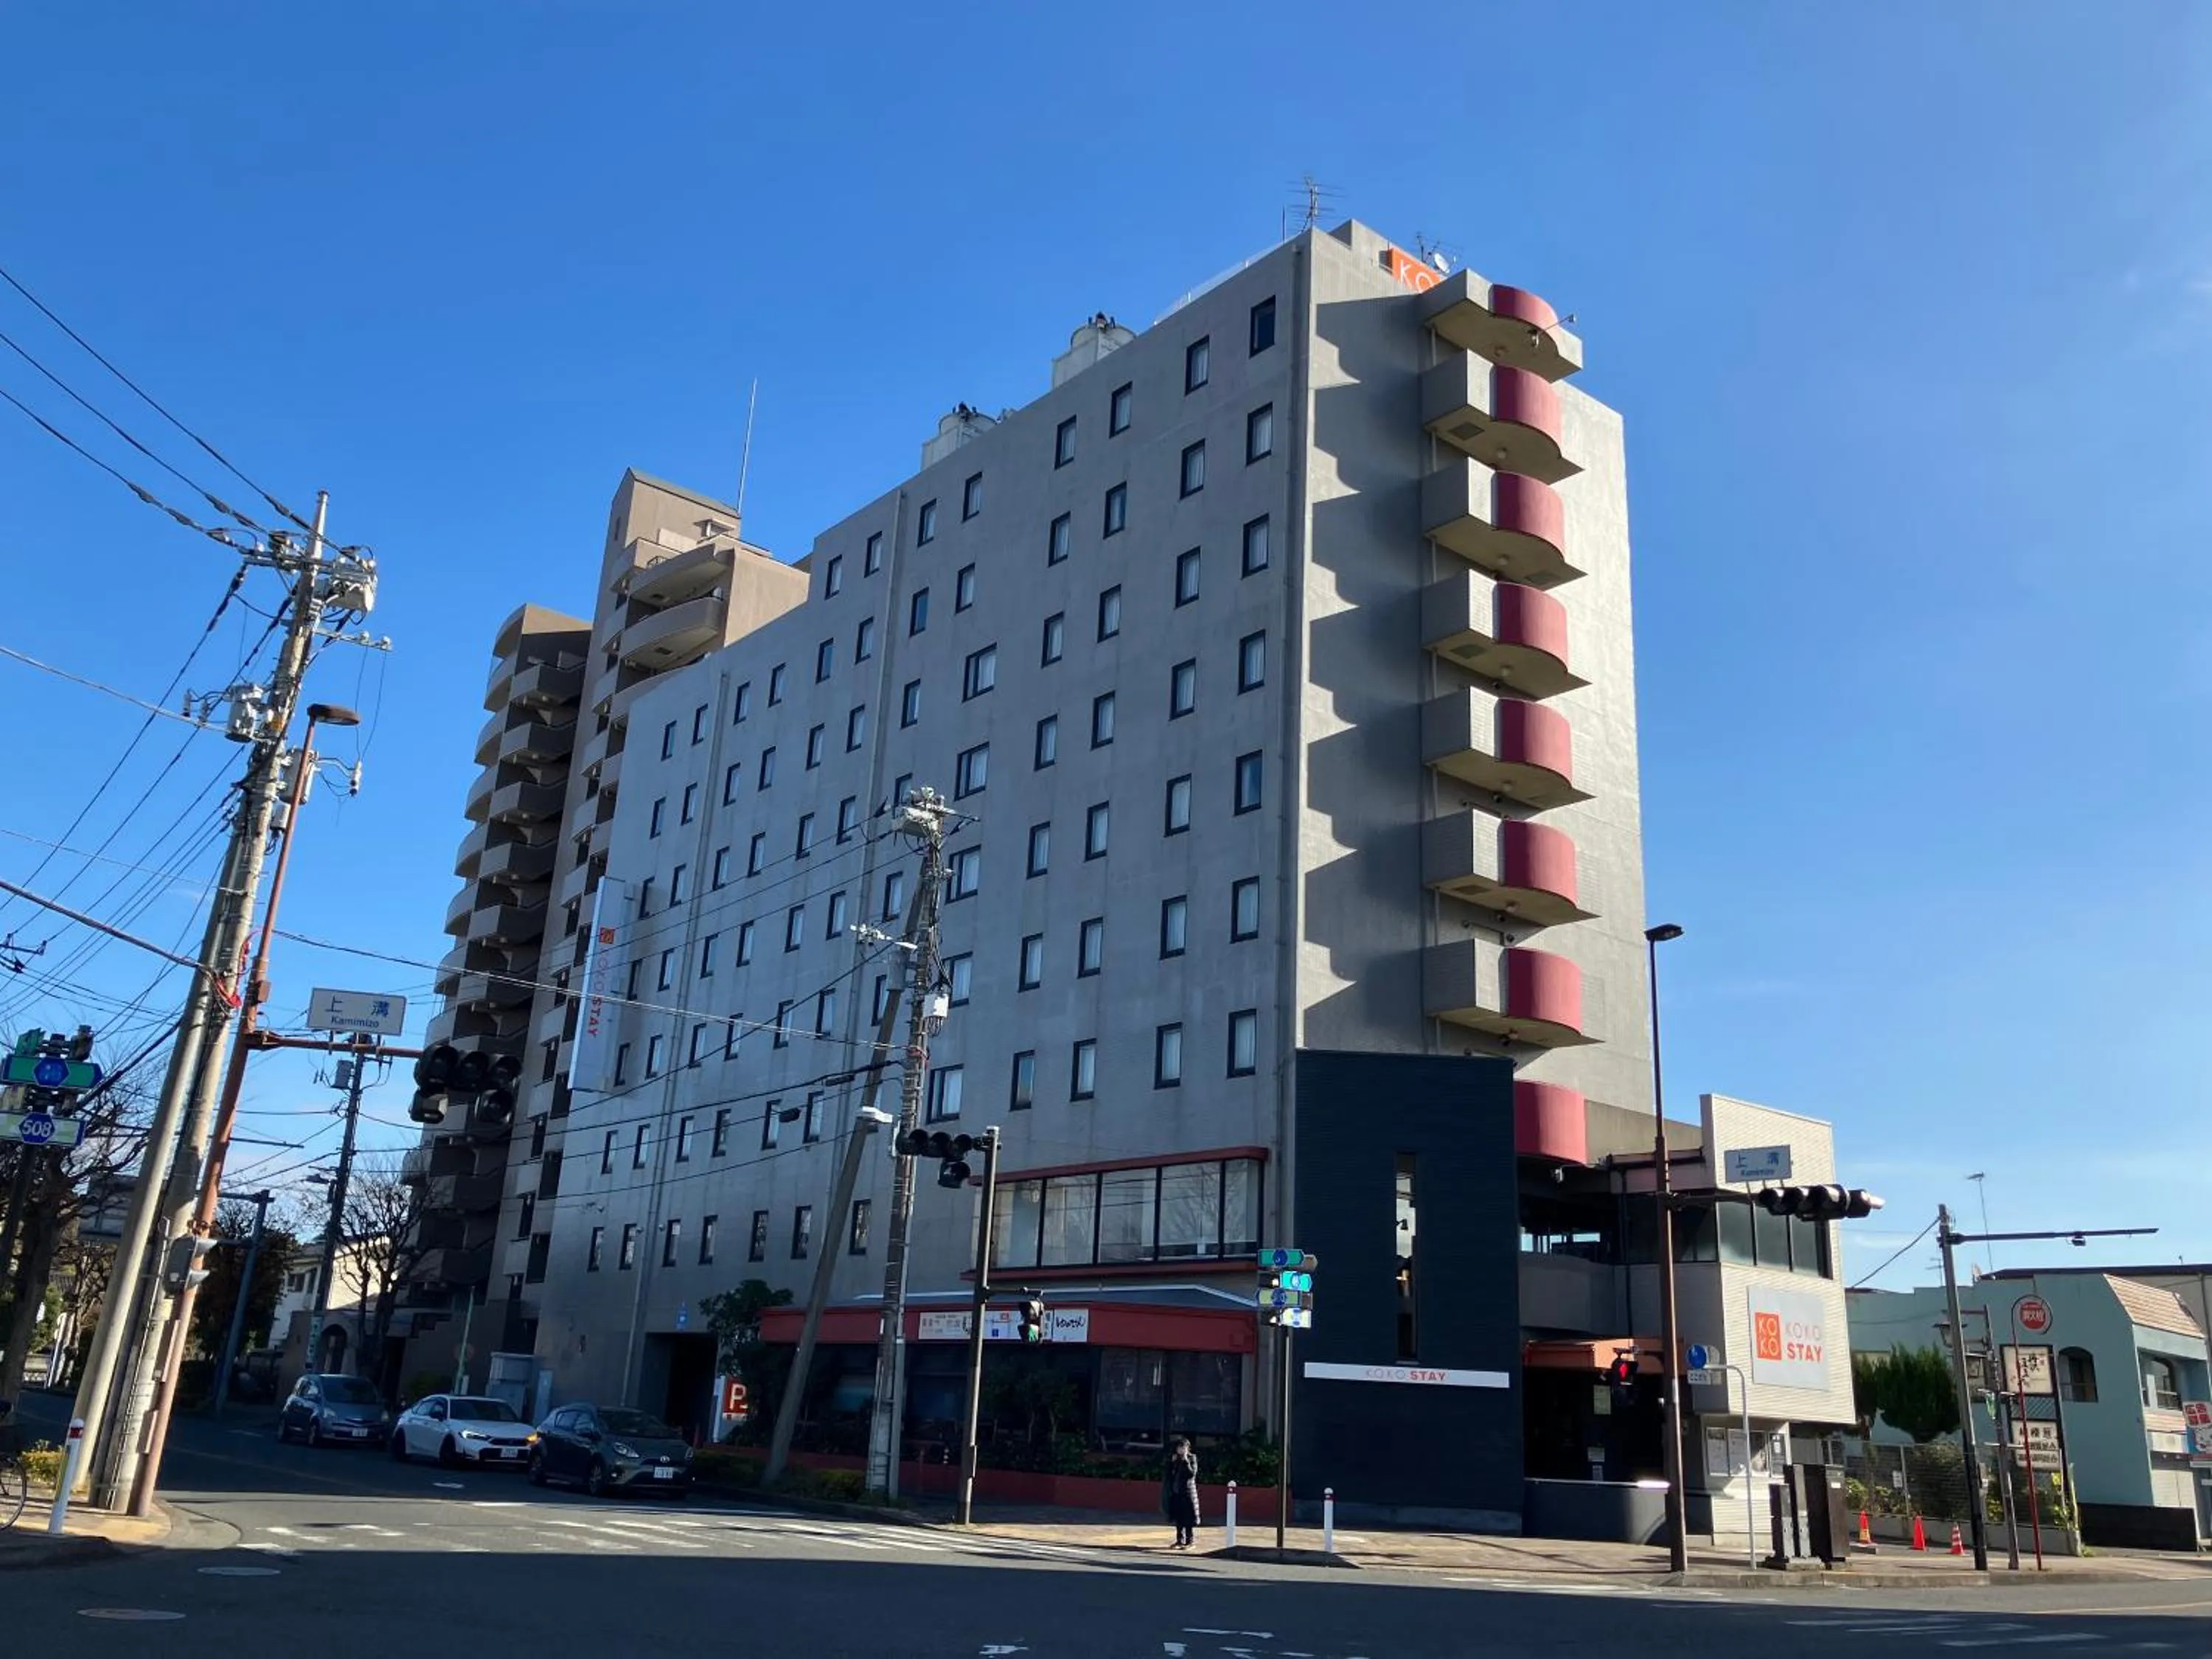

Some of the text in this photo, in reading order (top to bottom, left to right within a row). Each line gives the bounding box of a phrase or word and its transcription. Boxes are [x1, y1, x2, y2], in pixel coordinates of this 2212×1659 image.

[325, 995, 390, 1018] 上溝
[332, 1017, 380, 1028] Kamimizo
[23, 1120, 52, 1138] 508
[1785, 1322, 1821, 1341] KOKO
[1787, 1342, 1822, 1363] STAY
[1366, 1368, 1405, 1380] KOKO
[1410, 1370, 1446, 1381] STAY
[729, 1383, 746, 1410] P
